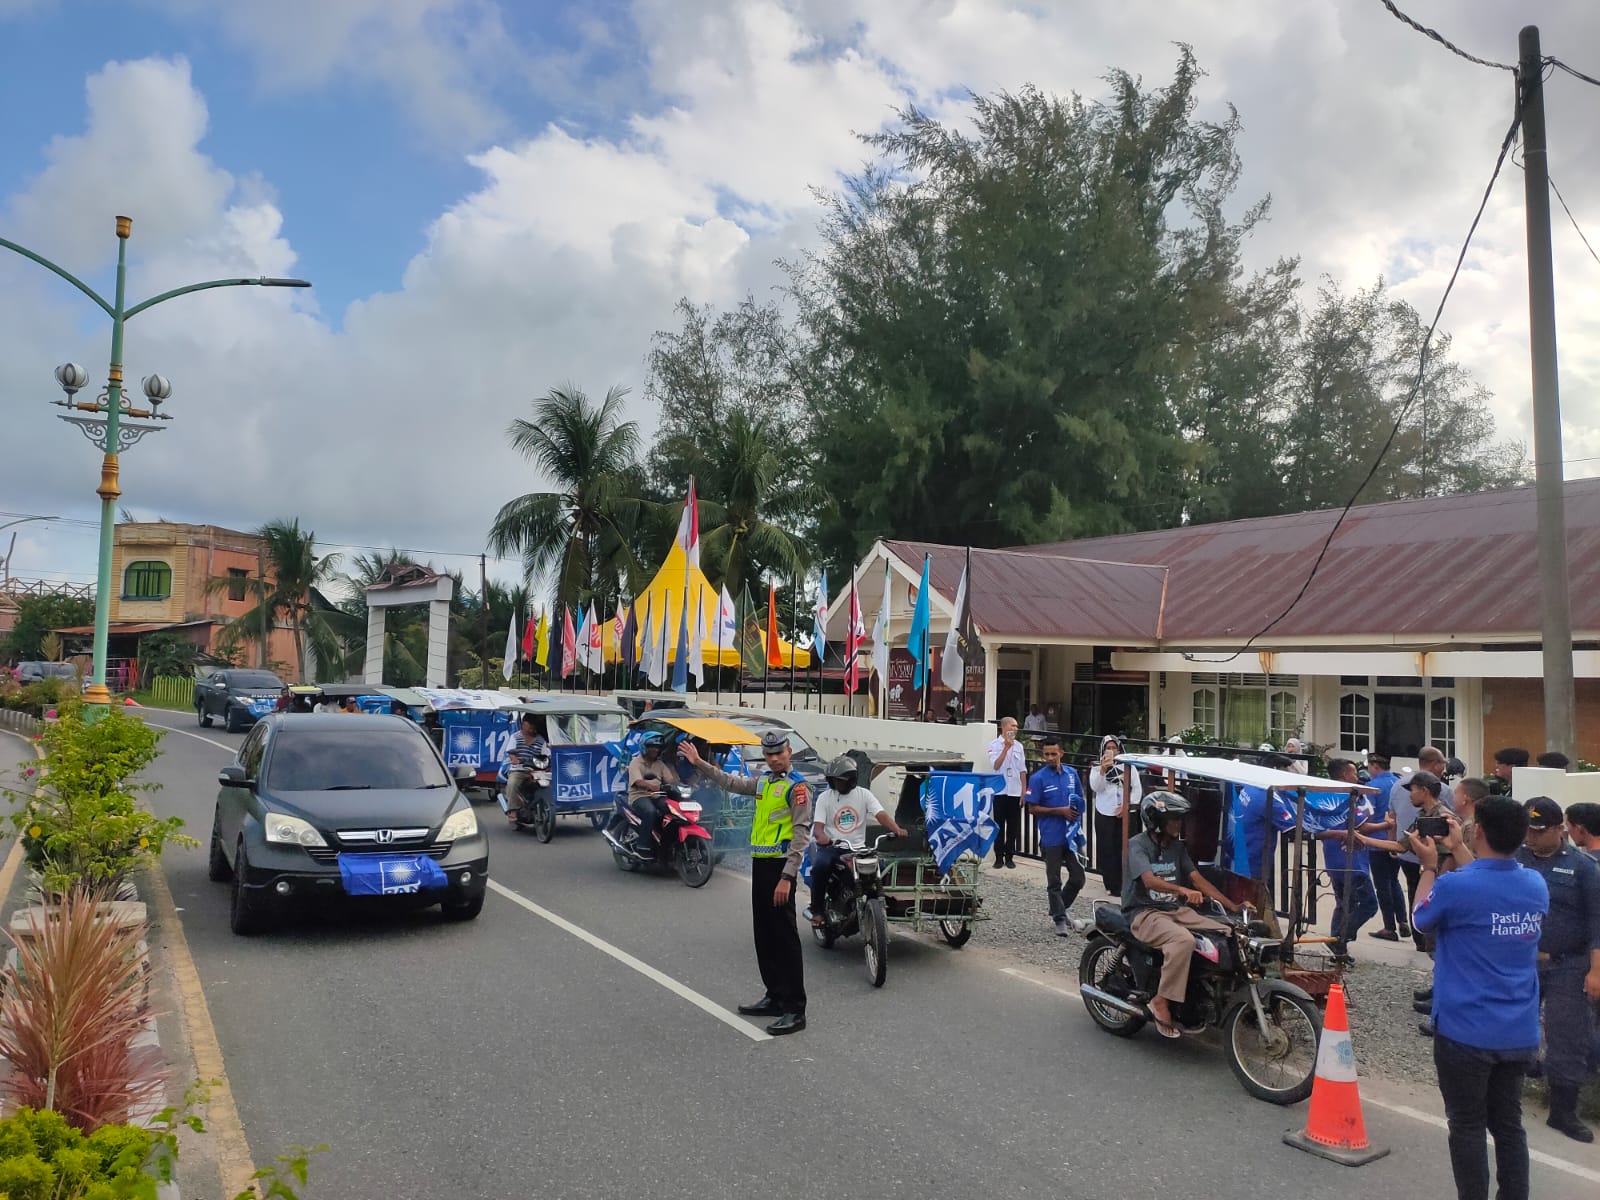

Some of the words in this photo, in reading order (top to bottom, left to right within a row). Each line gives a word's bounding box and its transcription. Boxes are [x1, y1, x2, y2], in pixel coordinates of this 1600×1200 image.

[450, 754, 480, 764] PAN
[595, 755, 628, 793] 12
[558, 784, 590, 798] PAN
[1491, 912, 1520, 924] Pasti
[1491, 922, 1541, 936] HaraPAN
